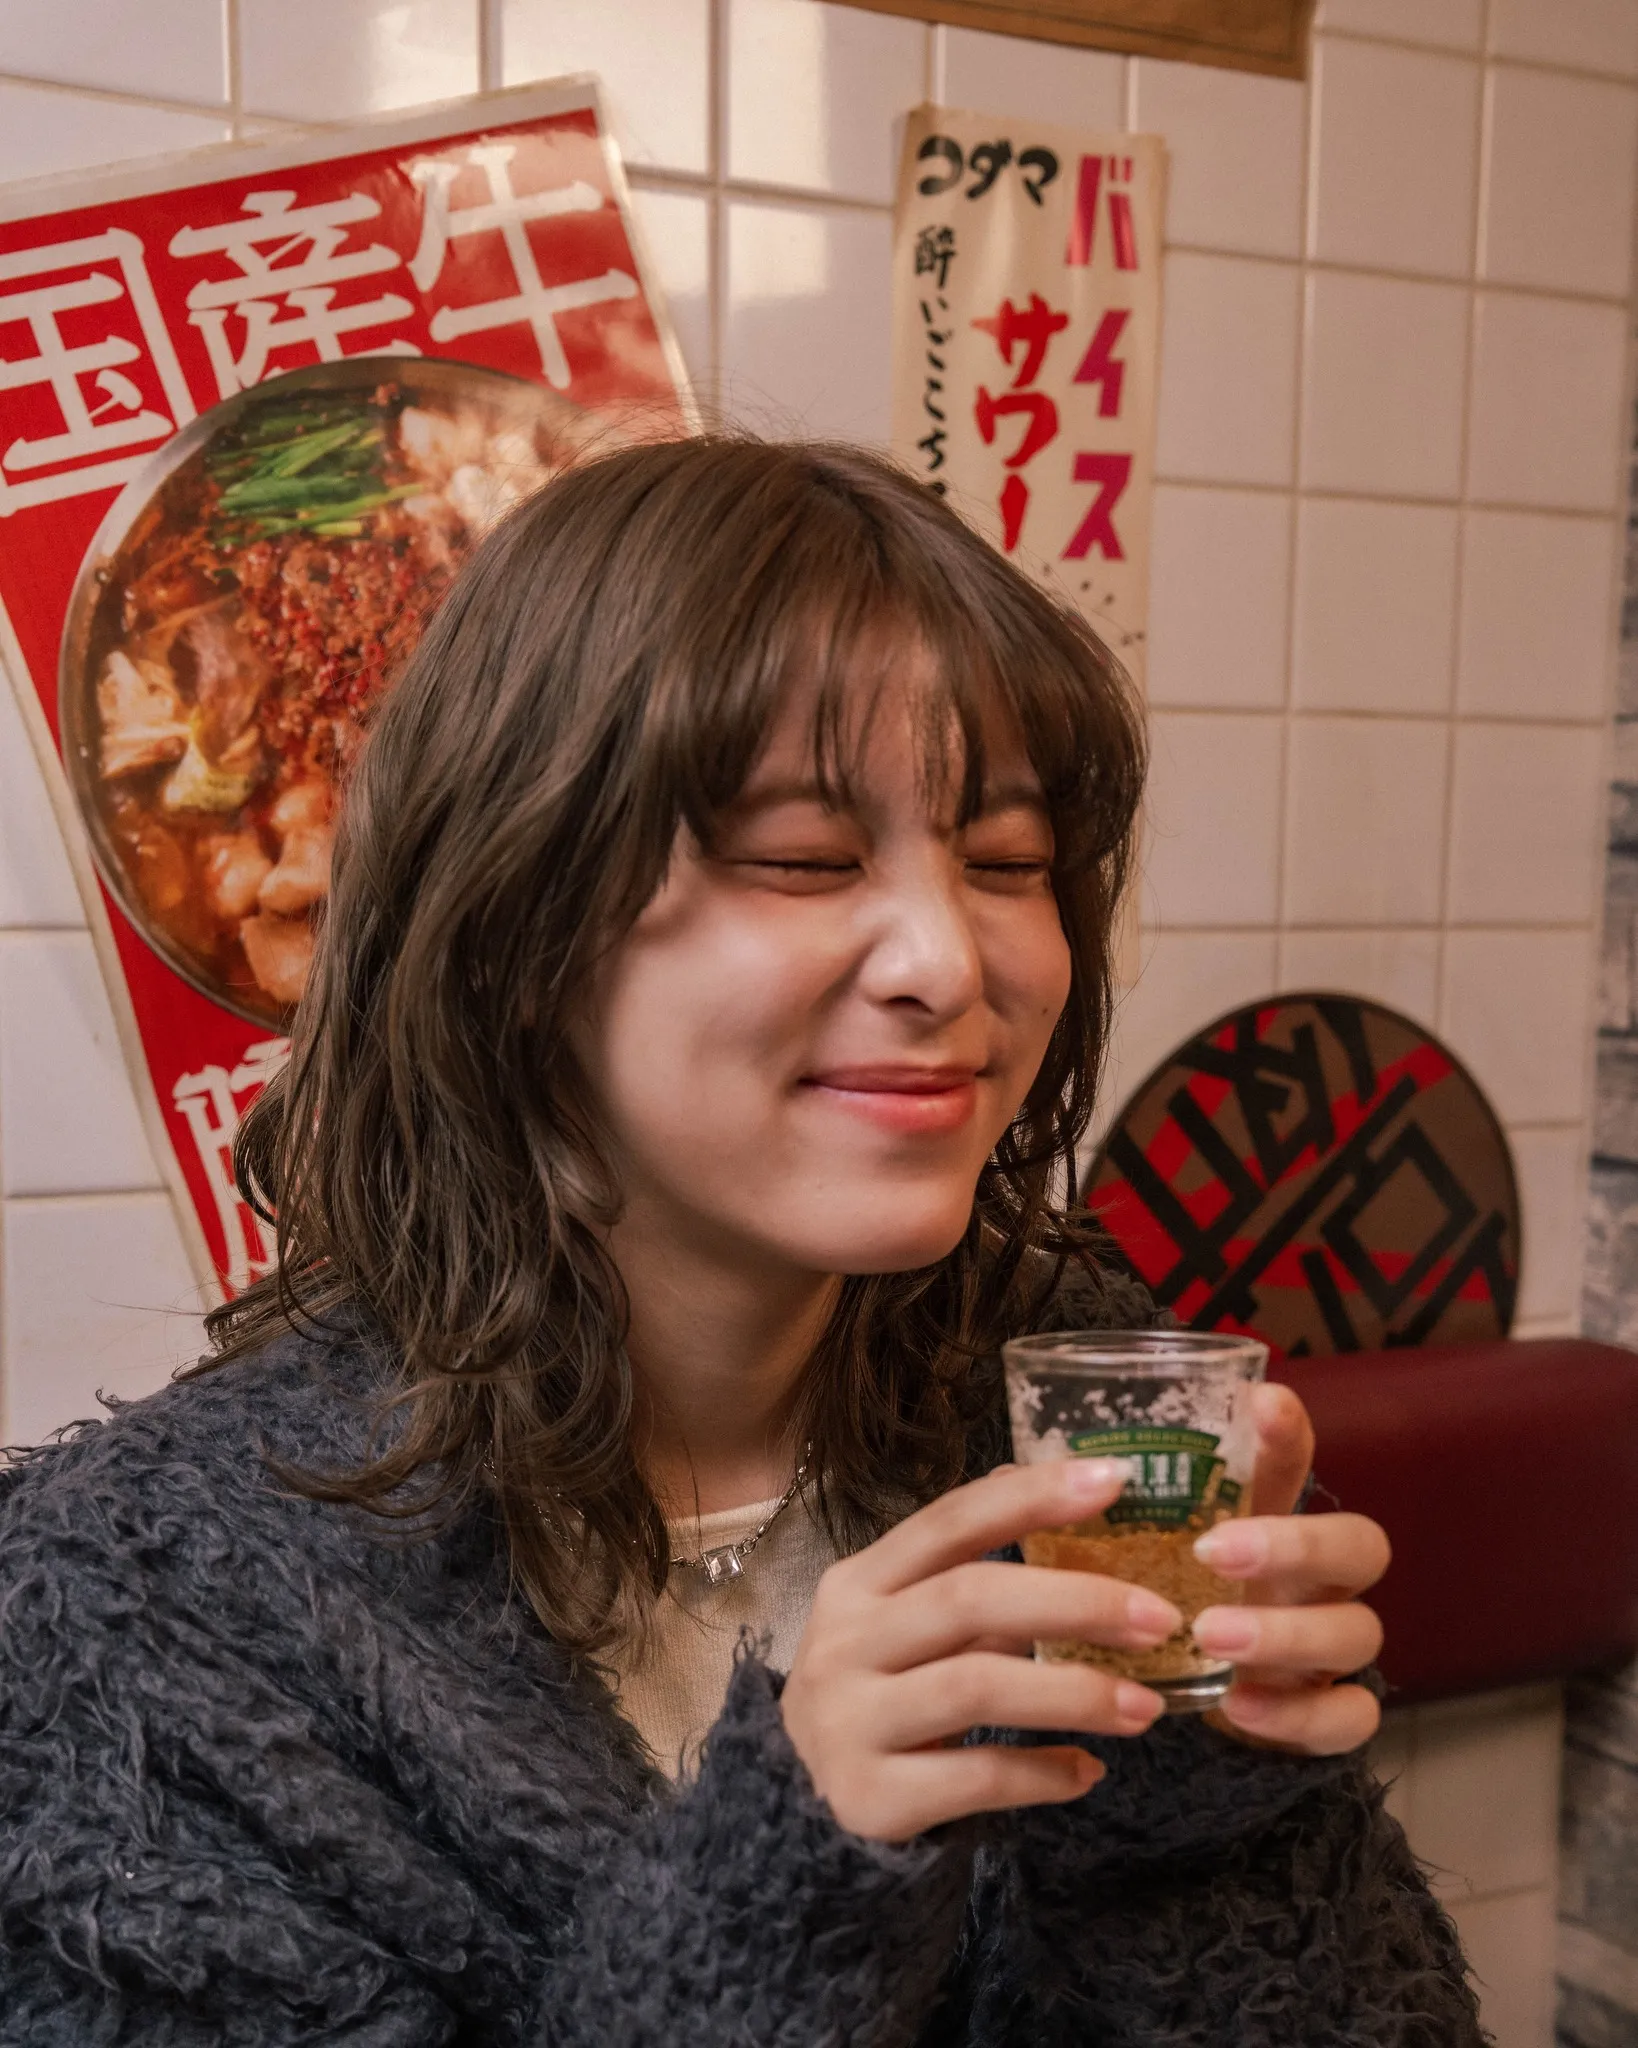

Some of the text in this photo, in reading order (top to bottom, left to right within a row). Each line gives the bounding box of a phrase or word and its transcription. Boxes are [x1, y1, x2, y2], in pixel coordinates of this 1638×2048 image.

[0, 143, 640, 518] 国産牛
[968, 291, 1070, 555] サワー
[1061, 154, 1139, 561] バイス
